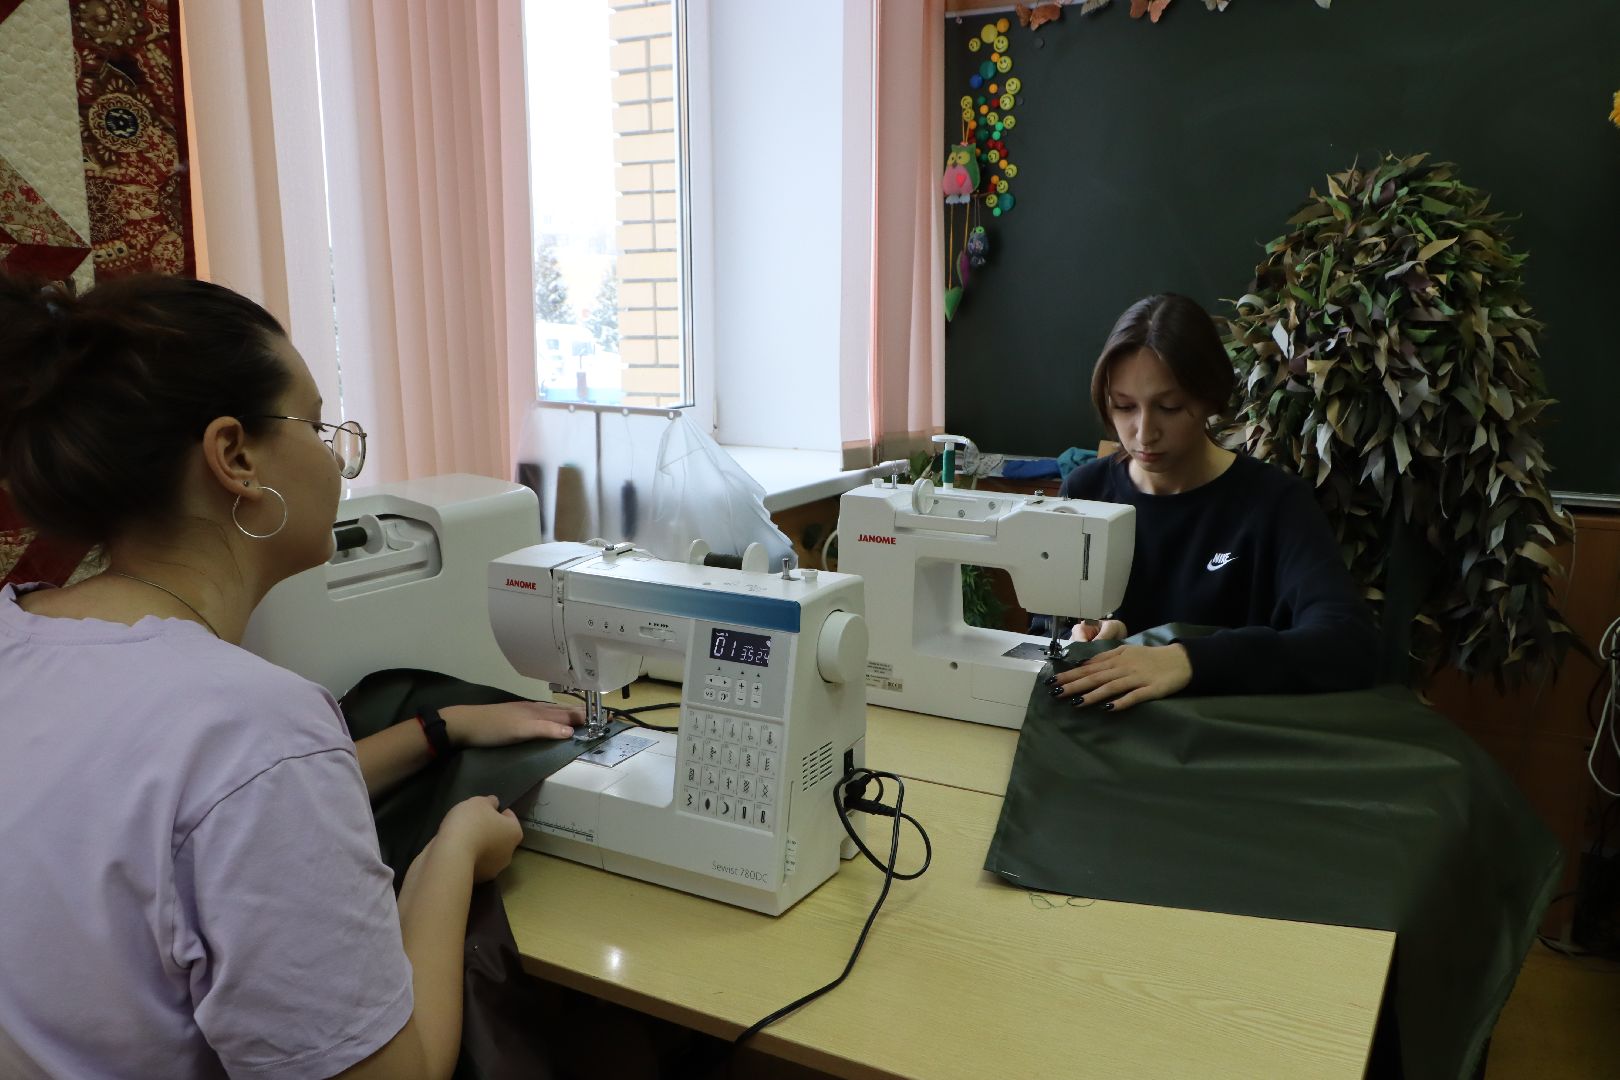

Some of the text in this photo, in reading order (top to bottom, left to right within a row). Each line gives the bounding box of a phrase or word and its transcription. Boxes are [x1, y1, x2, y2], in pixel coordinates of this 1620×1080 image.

[858, 534, 897, 545] JANOME
[1212, 552, 1231, 563] NIKE
[505, 578, 537, 590] JANOME
